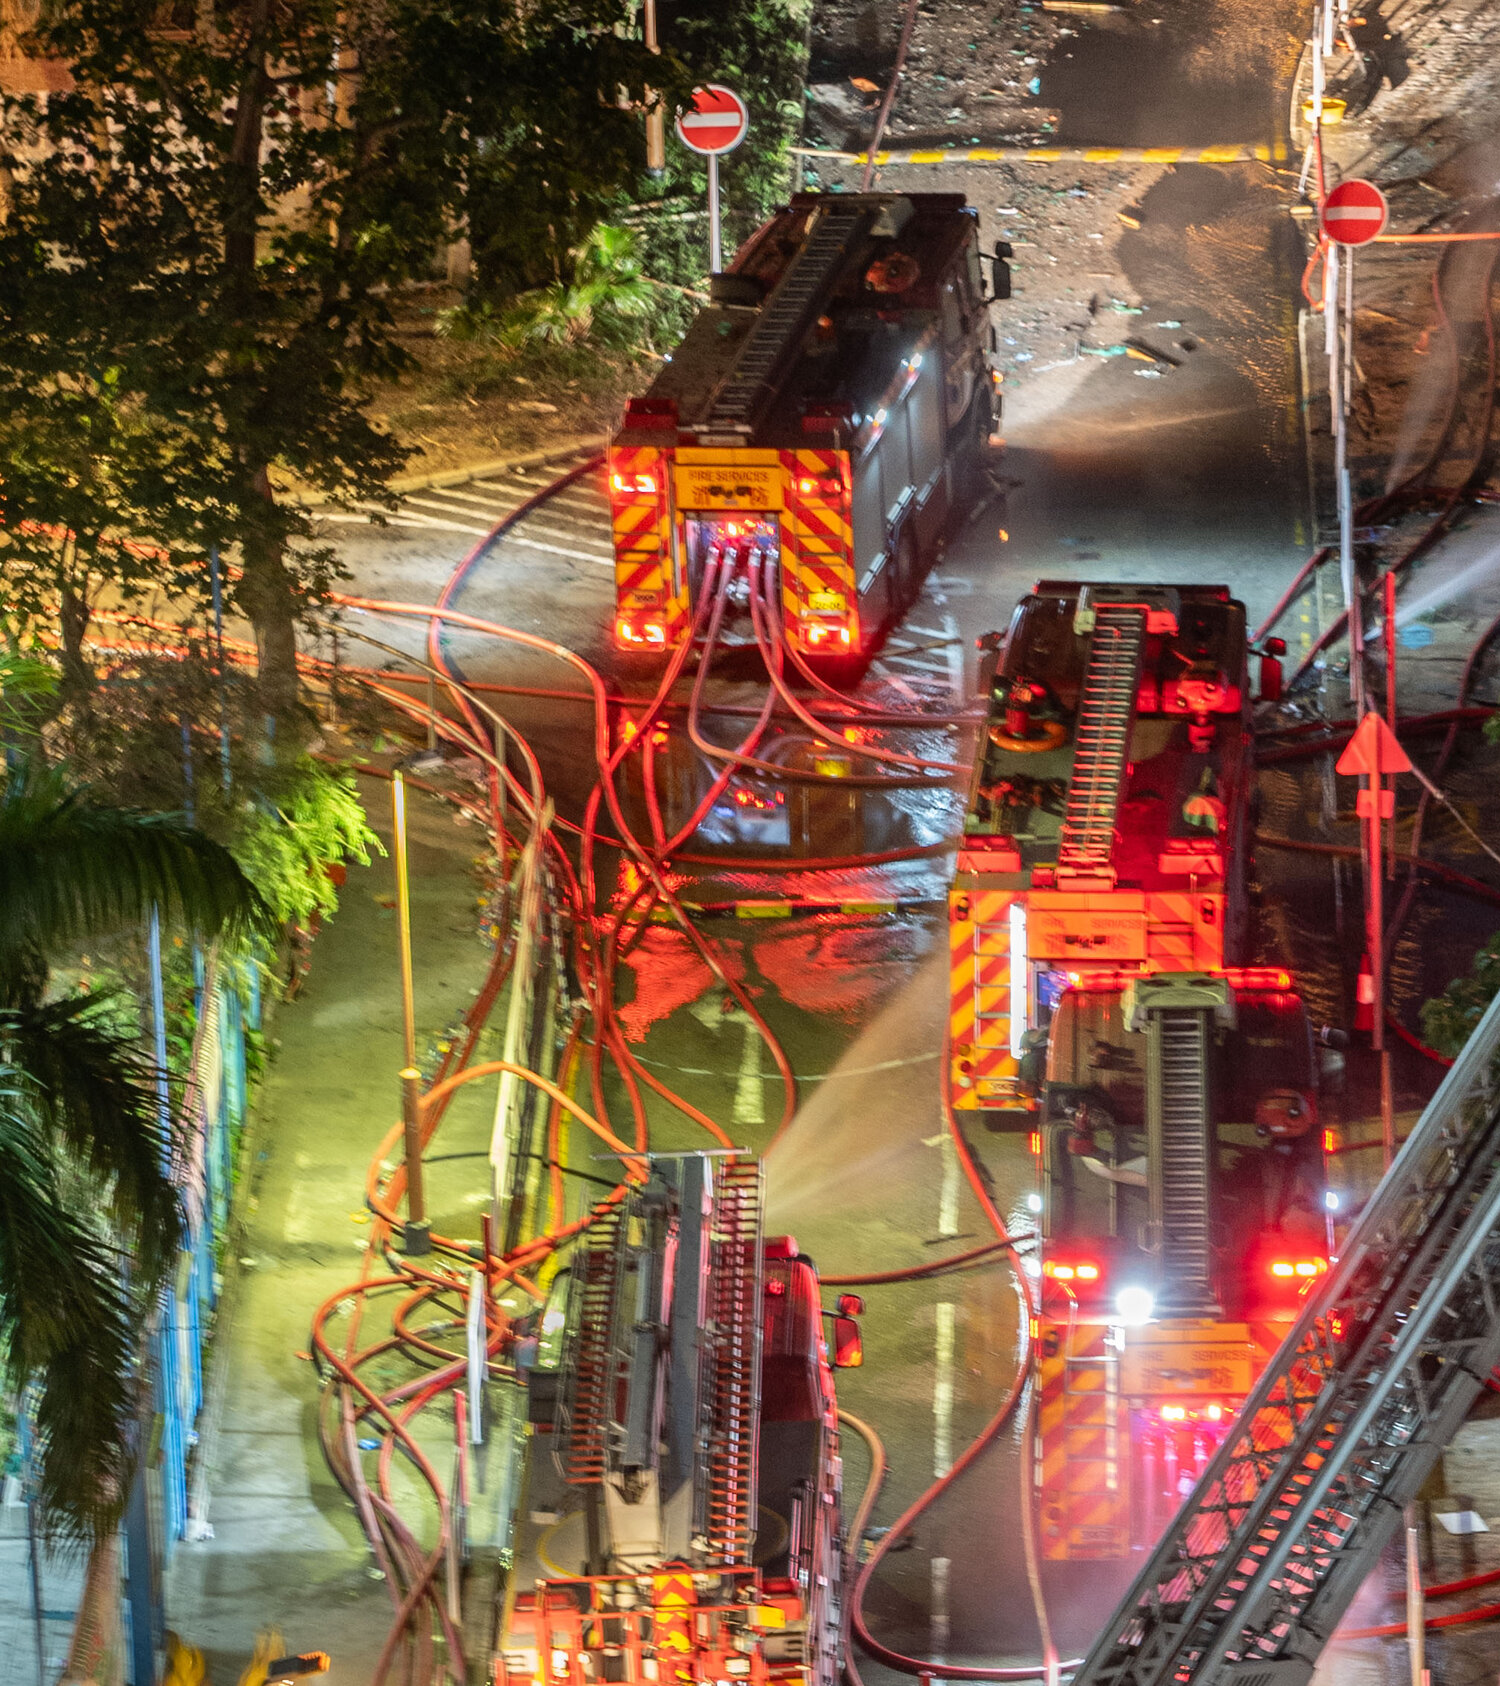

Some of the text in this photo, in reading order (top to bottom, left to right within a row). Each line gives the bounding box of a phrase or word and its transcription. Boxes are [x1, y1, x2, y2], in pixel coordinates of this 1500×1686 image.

[688, 470, 769, 482] FIRE SERVICES
[1191, 1349, 1249, 1361] SERVICES
